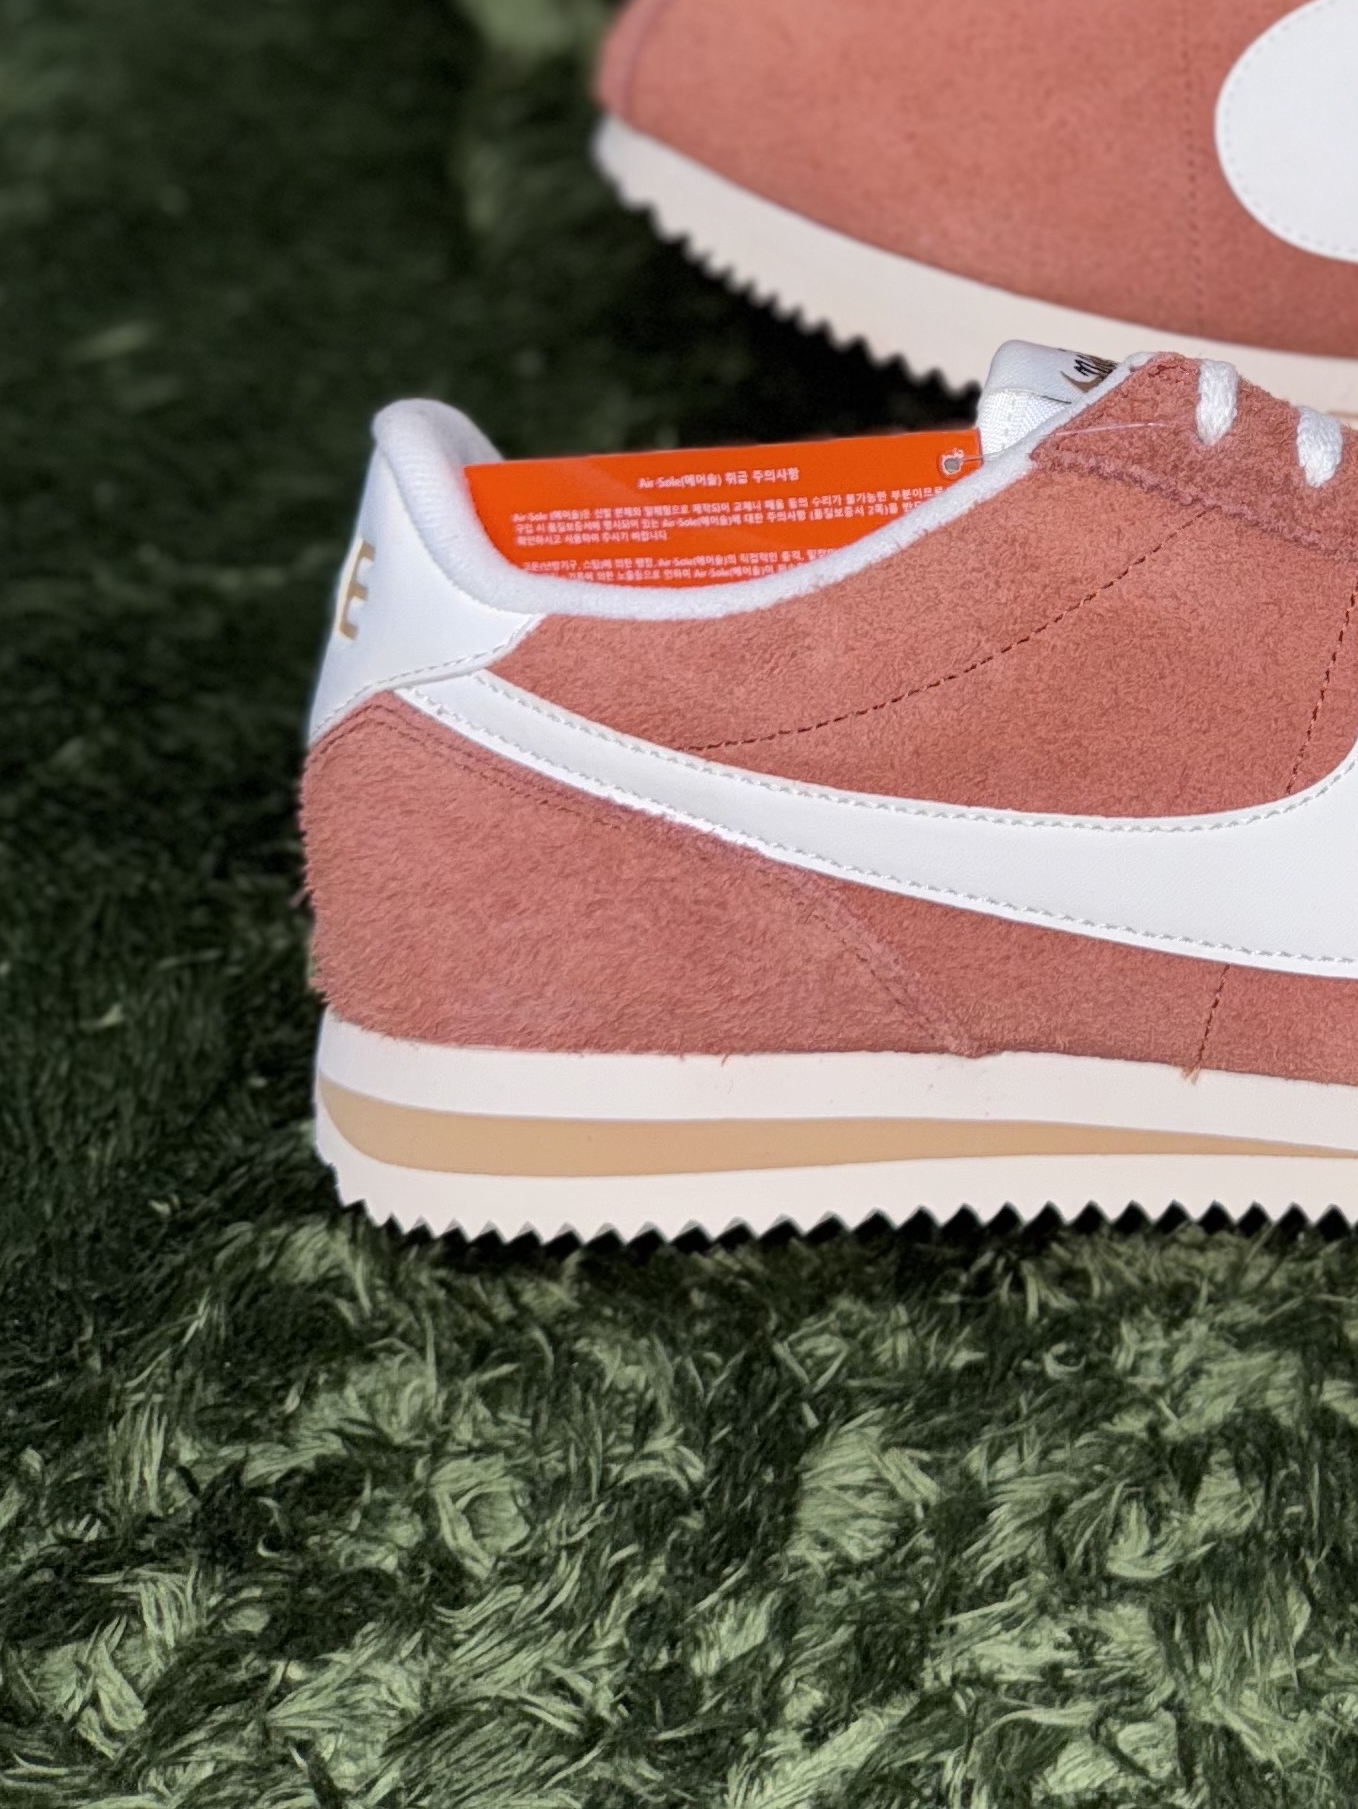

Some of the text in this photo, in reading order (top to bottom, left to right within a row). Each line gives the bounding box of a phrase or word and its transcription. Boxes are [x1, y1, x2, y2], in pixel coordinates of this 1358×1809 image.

[724, 470, 748, 486] 취급
[752, 467, 800, 484] 주의사항
[812, 494, 843, 508] 수리가
[846, 490, 888, 505] 불가능한
[891, 485, 944, 501] 부분이므로
[767, 509, 807, 523] 주의사항
